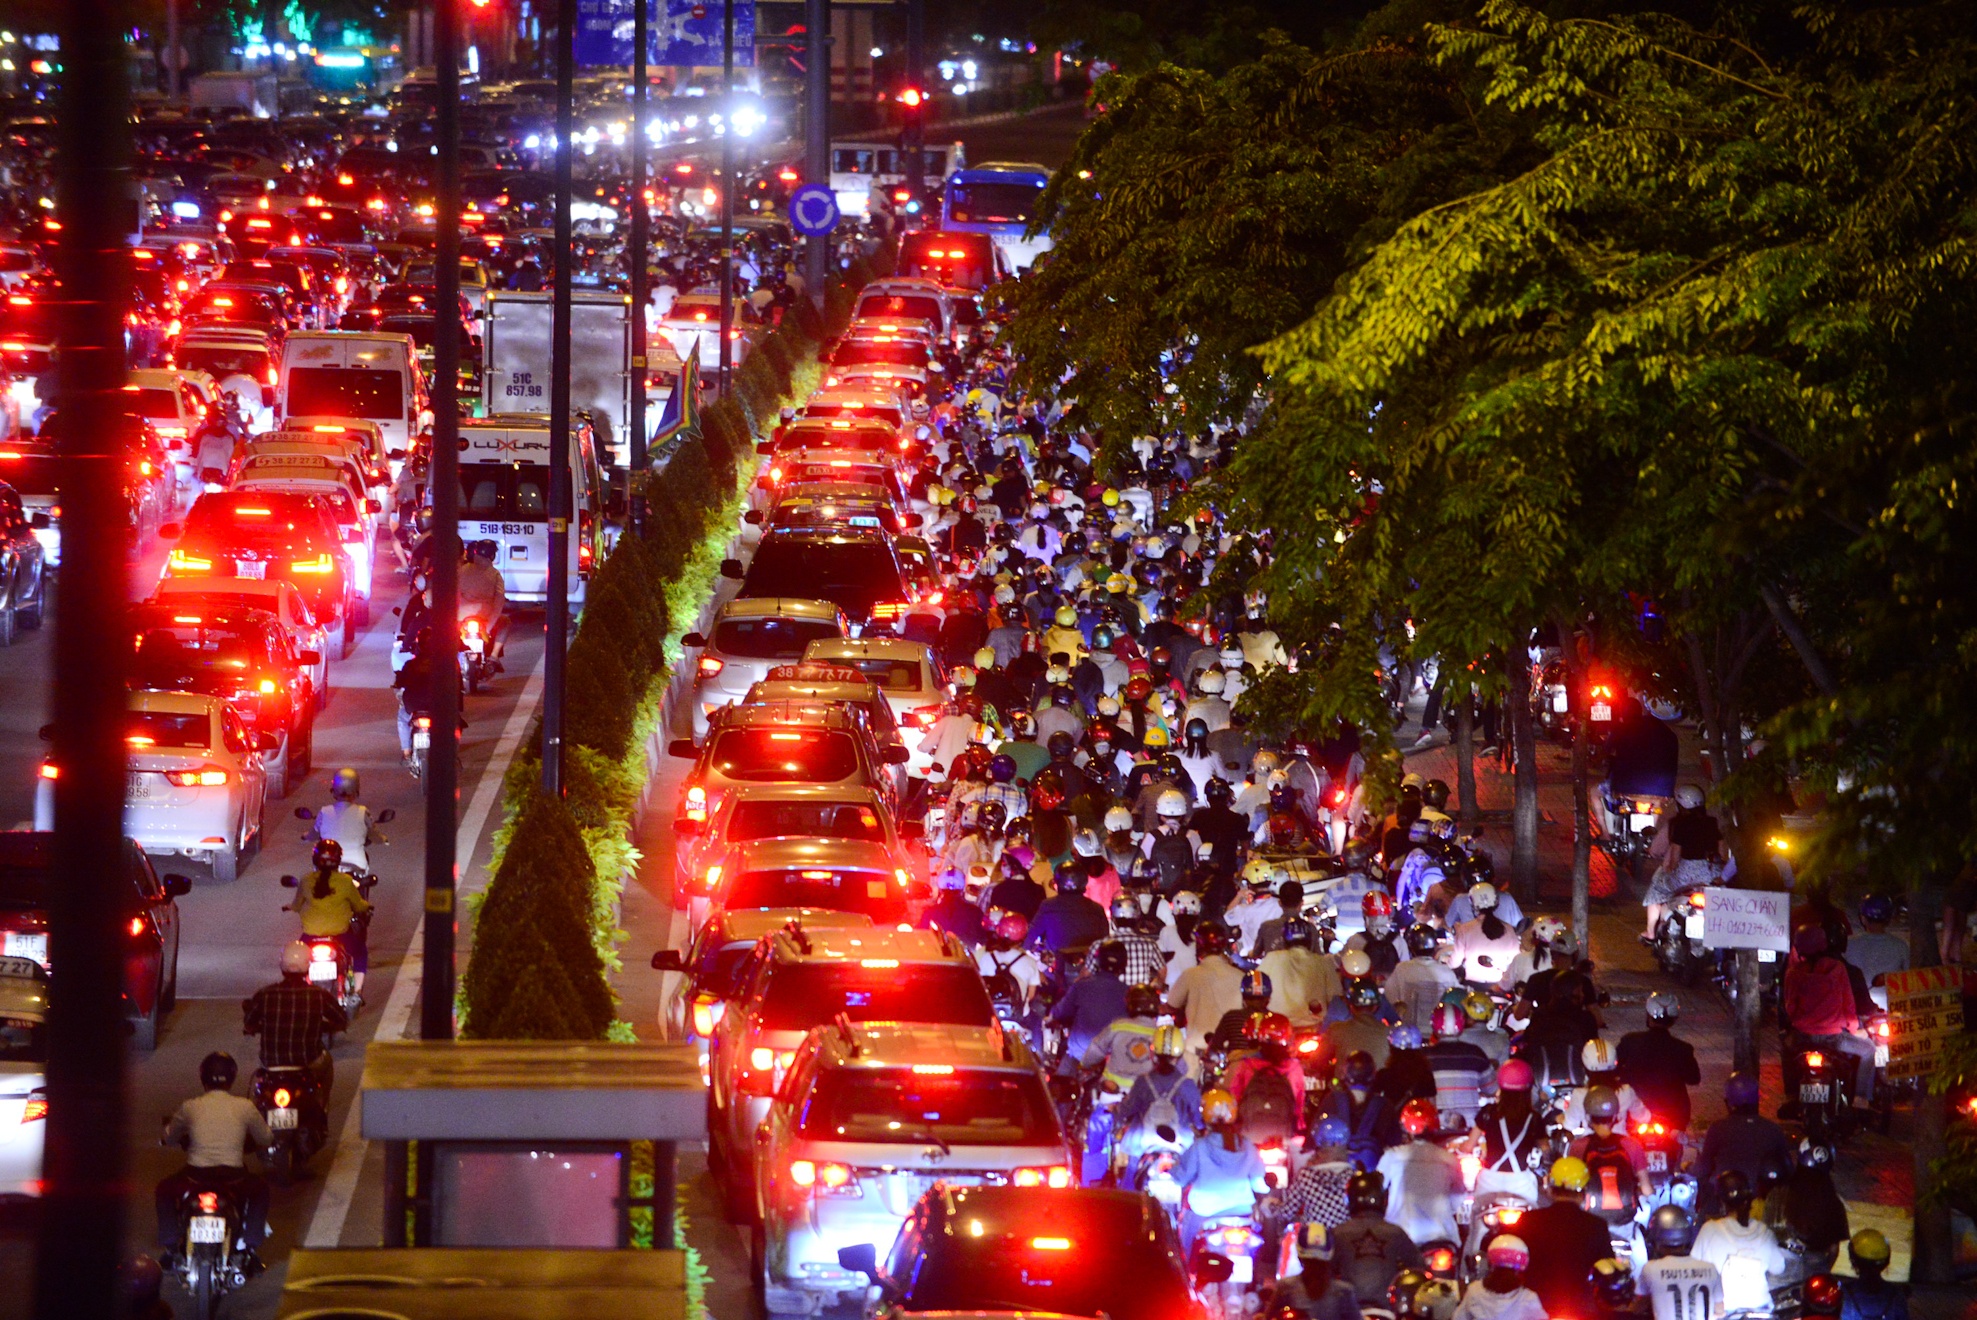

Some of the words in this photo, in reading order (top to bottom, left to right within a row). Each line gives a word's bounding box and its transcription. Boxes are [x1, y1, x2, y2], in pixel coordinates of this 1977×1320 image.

[512, 372, 532, 384] 51C
[506, 385, 543, 396] 857.98
[300, 457, 310, 465] 27
[777, 667, 794, 678] 38
[836, 669, 854, 680] 77
[1711, 895, 1742, 913] SANG
[16, 936, 38, 948] 51F
[12, 962, 31, 974] 27
[1890, 1020, 1914, 1035] CAFE
[1891, 1042, 1914, 1057] SINH
[1667, 1283, 1710, 1320] 10
